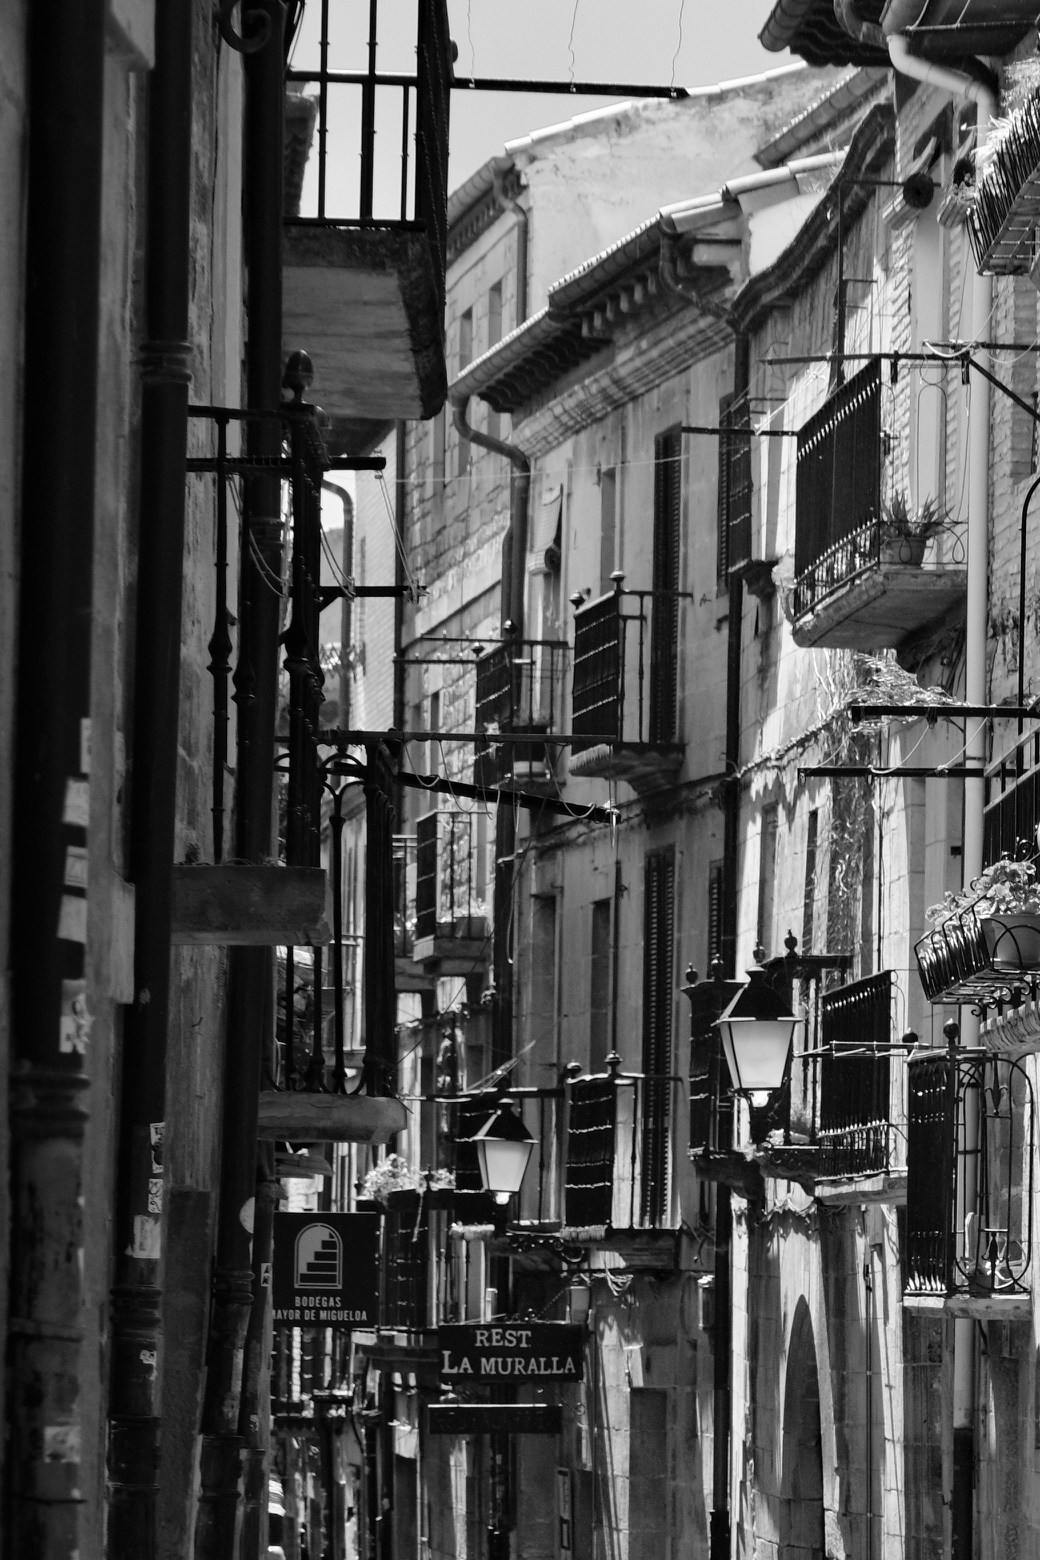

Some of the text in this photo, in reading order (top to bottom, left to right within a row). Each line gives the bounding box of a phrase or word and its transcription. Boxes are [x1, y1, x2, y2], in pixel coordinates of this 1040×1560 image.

[294, 1296, 342, 1308] BODEGAS
[304, 1309, 317, 1321] DE
[319, 1309, 368, 1322] MIGUELOA
[441, 1350, 577, 1375] LA MURALLA
